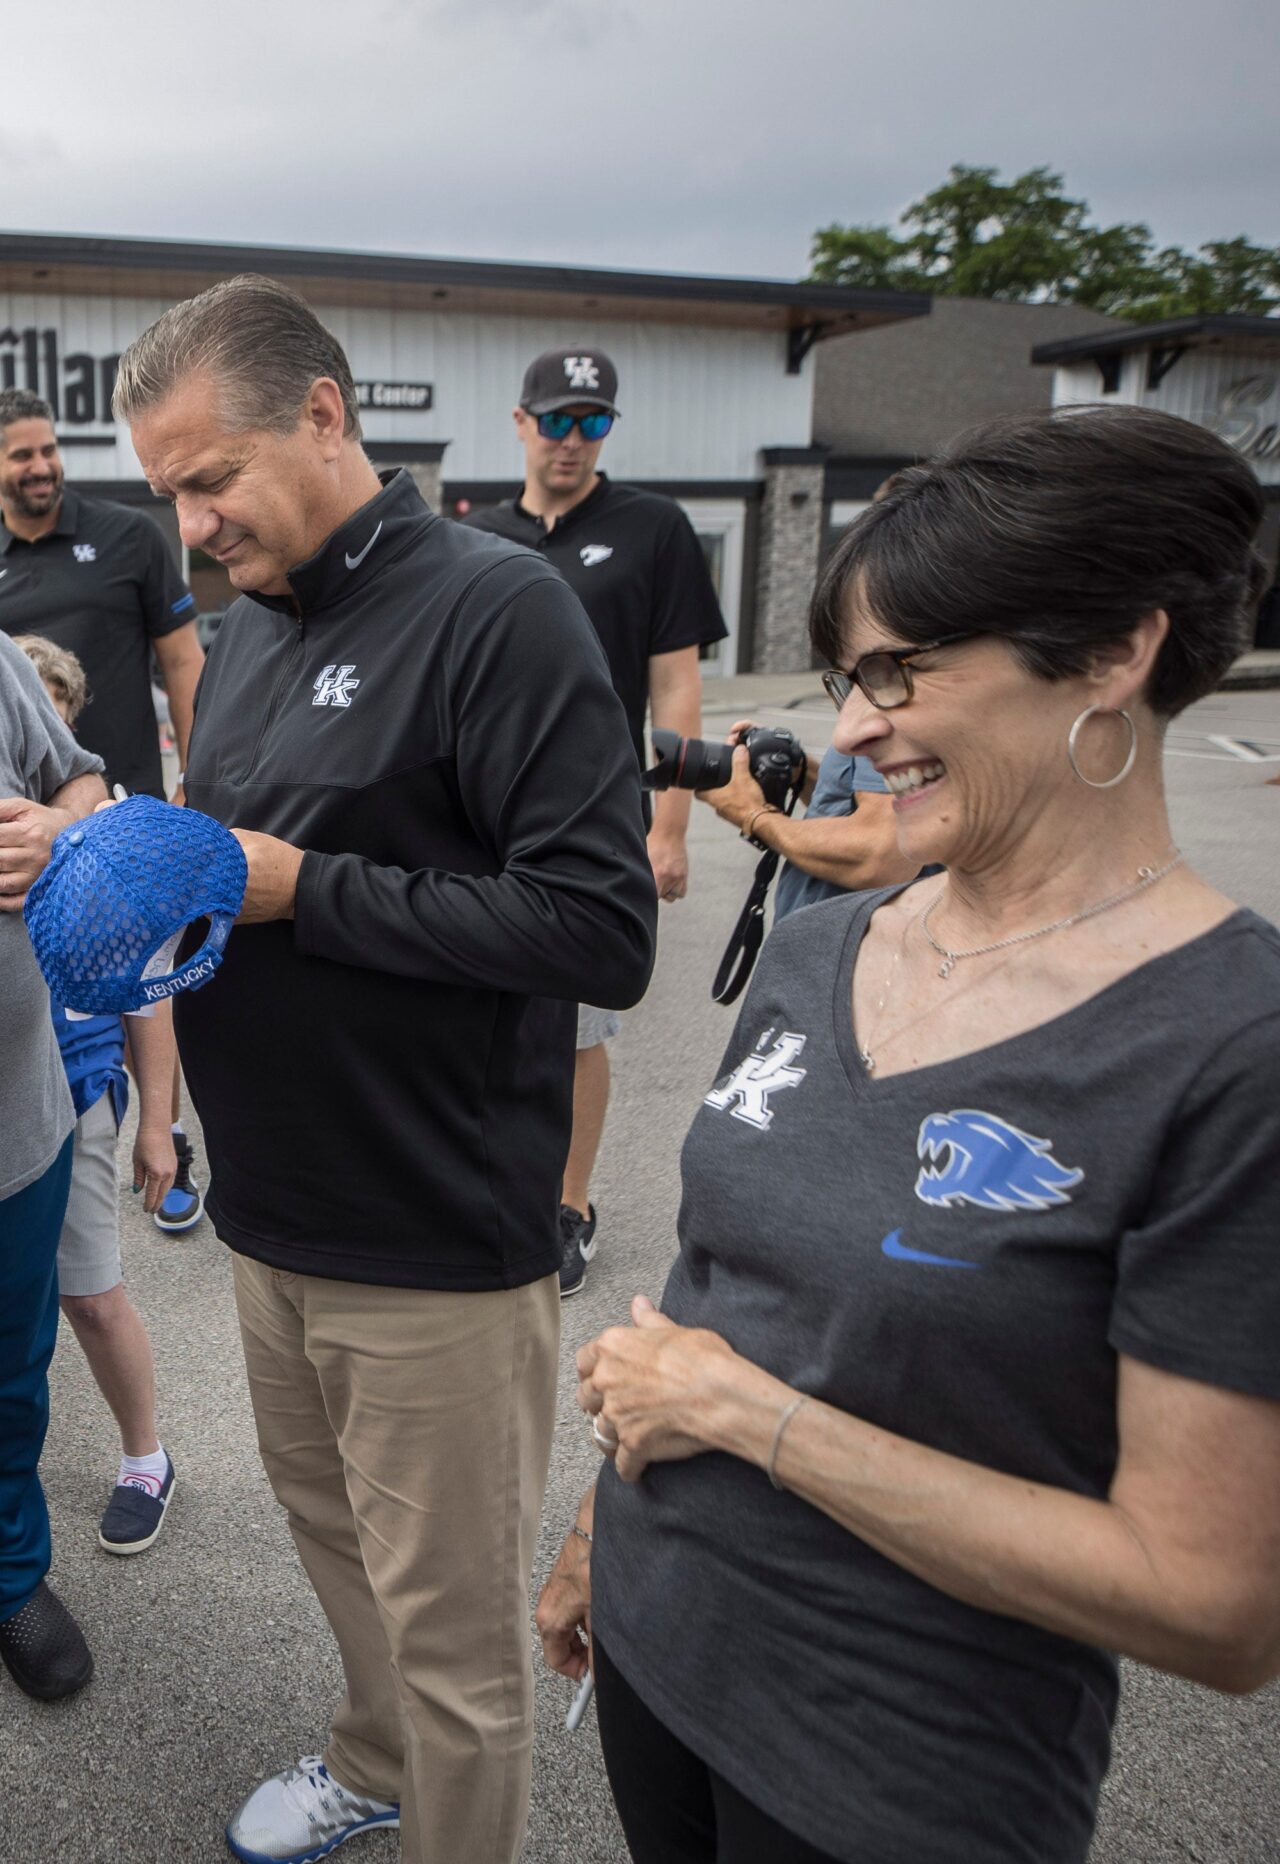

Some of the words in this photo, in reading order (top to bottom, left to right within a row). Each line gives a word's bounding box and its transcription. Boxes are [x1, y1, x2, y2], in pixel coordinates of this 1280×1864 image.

[563, 356, 600, 390] UK
[312, 664, 360, 707] UK
[144, 957, 215, 1001] KENTUCKY
